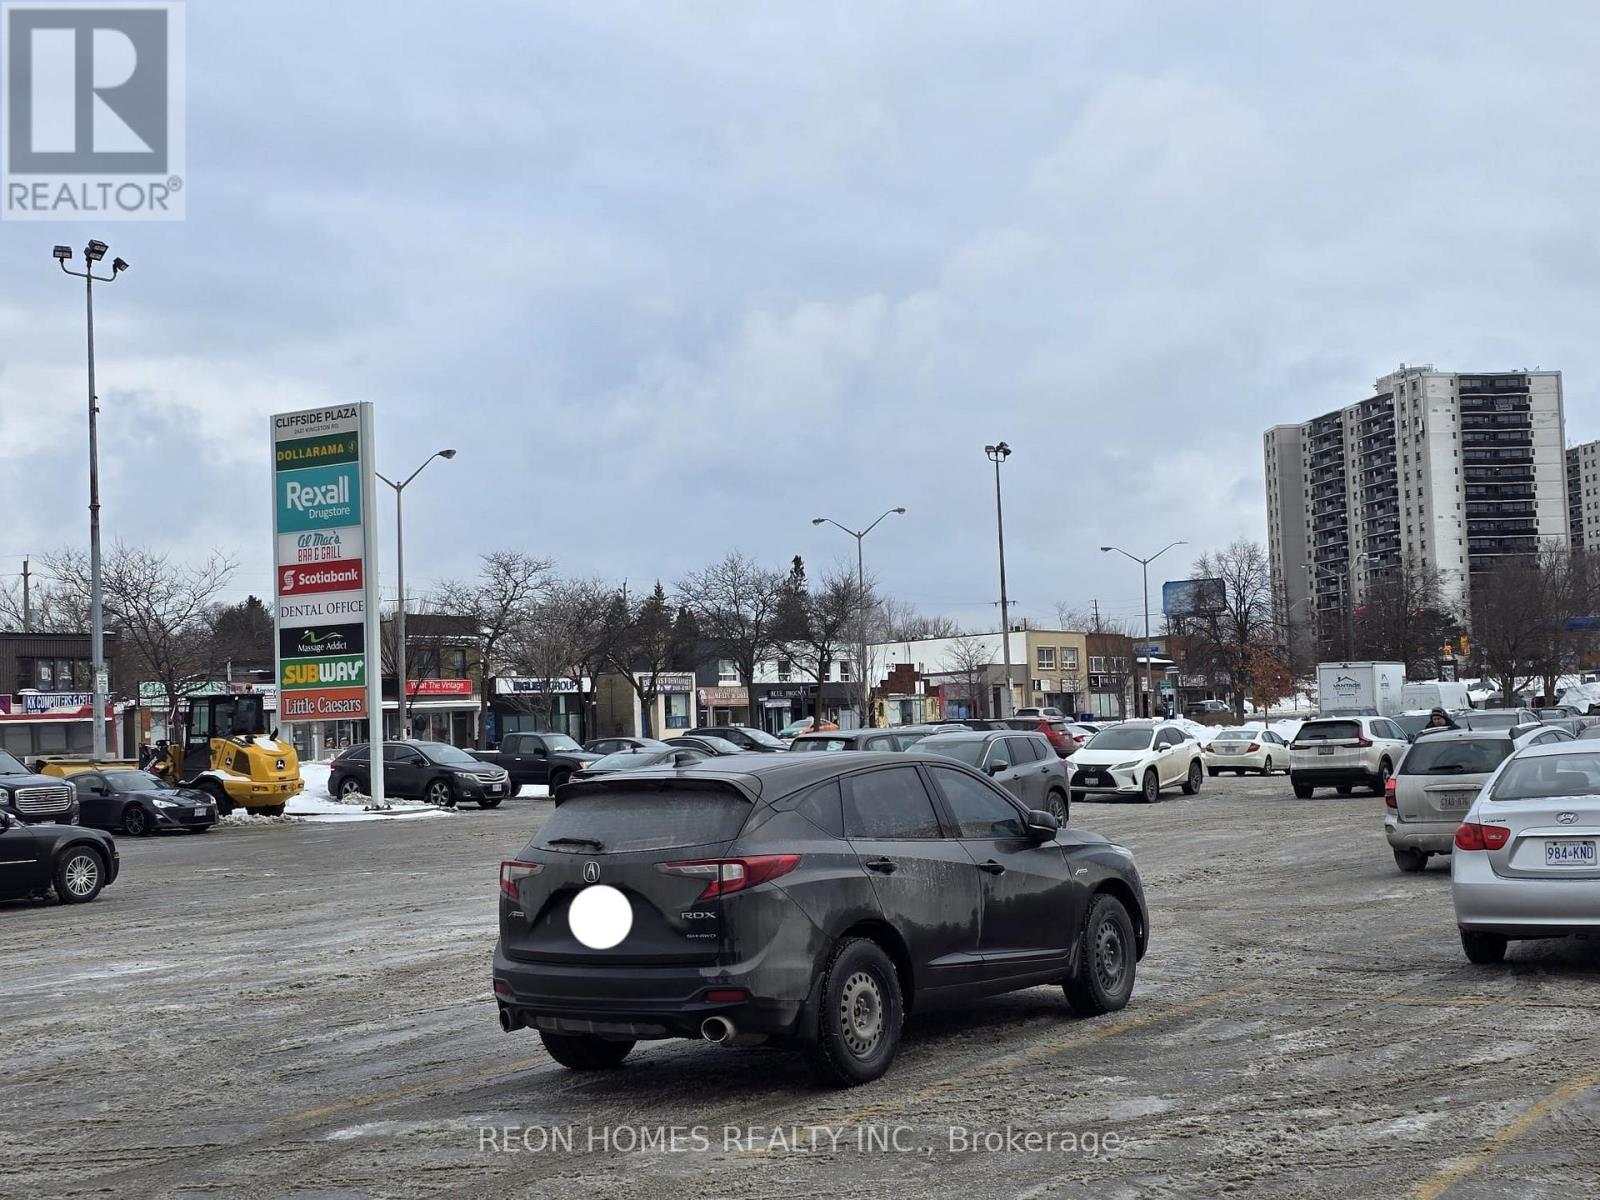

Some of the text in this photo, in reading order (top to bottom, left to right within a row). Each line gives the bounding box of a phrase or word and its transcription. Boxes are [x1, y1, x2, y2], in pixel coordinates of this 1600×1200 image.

[276, 408, 358, 428] CLIFFSIDE PLAZA
[277, 443, 345, 462] DOLLARAMA
[286, 475, 349, 511] Rexall
[309, 506, 351, 520] Drugstore
[313, 530, 342, 546] Mac's
[298, 548, 312, 562] BAR
[321, 545, 342, 560] GRILL
[298, 568, 359, 586] Scotiabank
[281, 600, 364, 618] DENTAL OFFICE
[297, 640, 347, 653] Massage Addict
[282, 659, 365, 685] SUBWAY
[410, 681, 427, 689] Wat
[441, 681, 464, 691] Vintage
[27, 695, 36, 709] KK
[36, 695, 72, 709] COMPUTERS
[285, 697, 315, 715] Little
[317, 695, 361, 713] Caesars
[1547, 847, 1567, 860] 984
[681, 911, 717, 920] RDX
